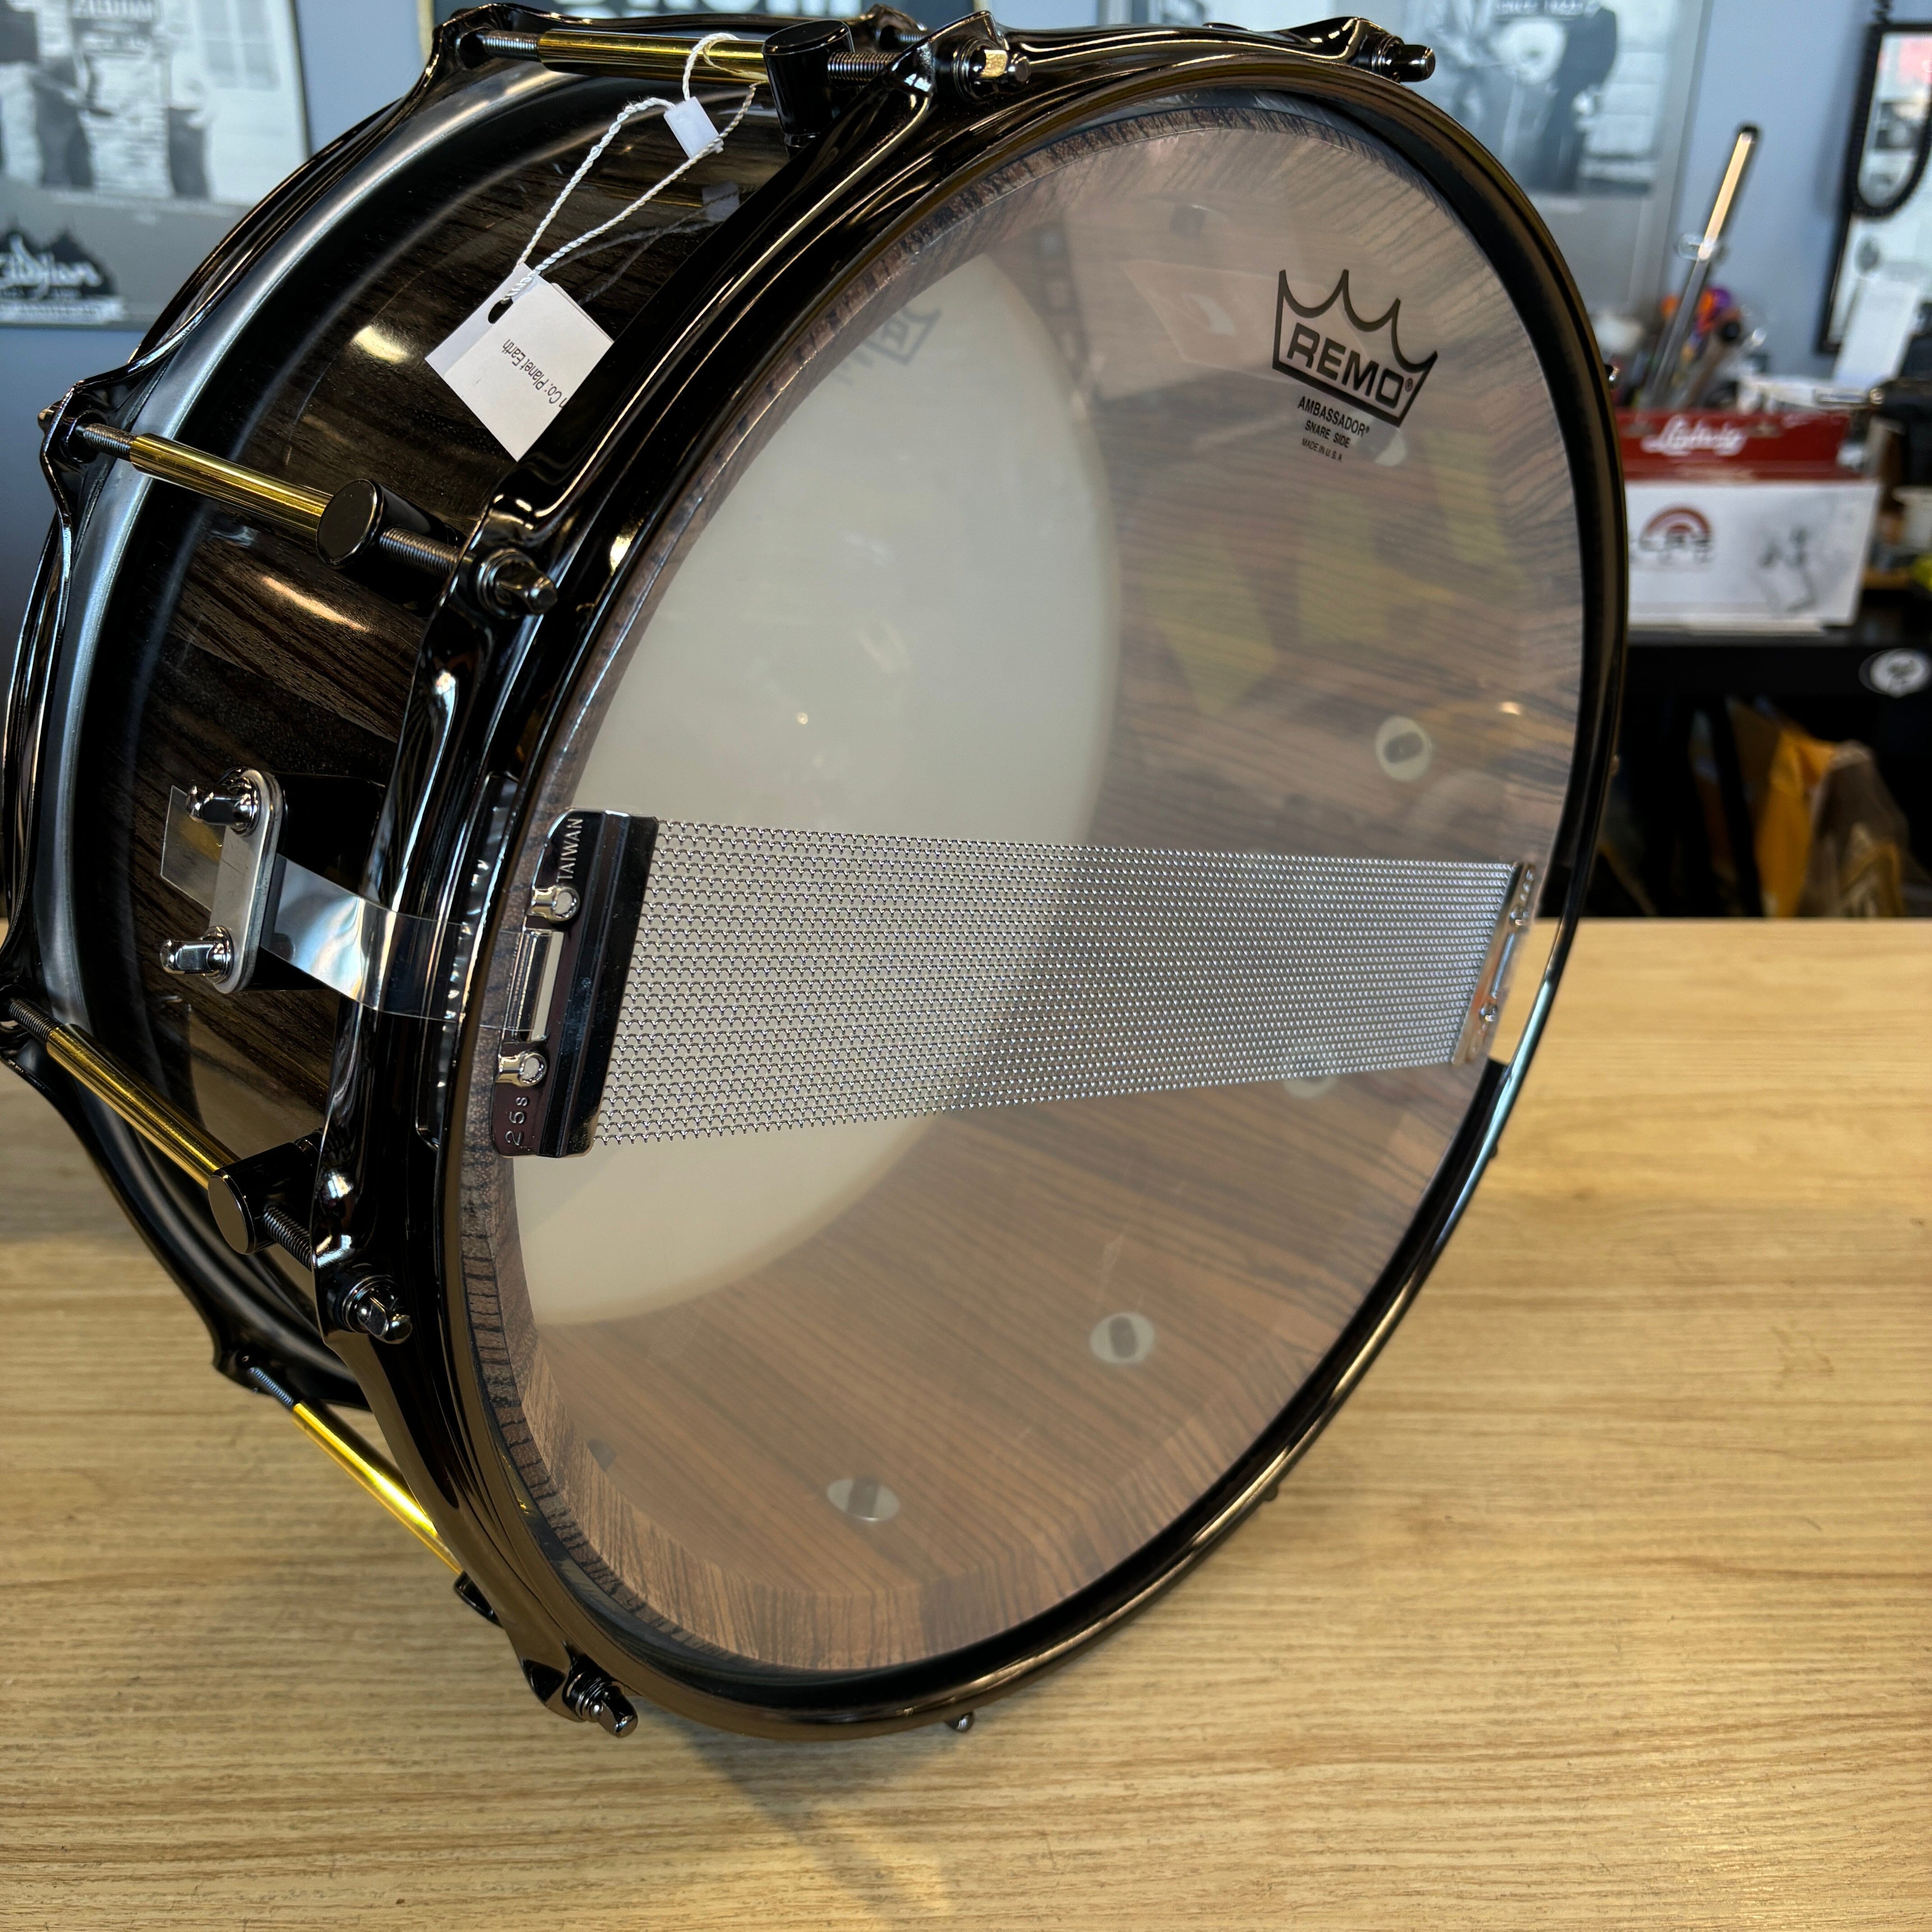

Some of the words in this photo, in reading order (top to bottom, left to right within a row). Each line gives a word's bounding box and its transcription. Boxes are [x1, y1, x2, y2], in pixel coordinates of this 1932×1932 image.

[501, 339, 526, 366] Earth
[520, 359, 549, 391] Planet
[1302, 437, 1319, 451] MADE
[1305, 419, 1331, 440] SNARE
[1333, 432, 1351, 448] SIDE
[556, 818, 583, 883] TAIWAN
